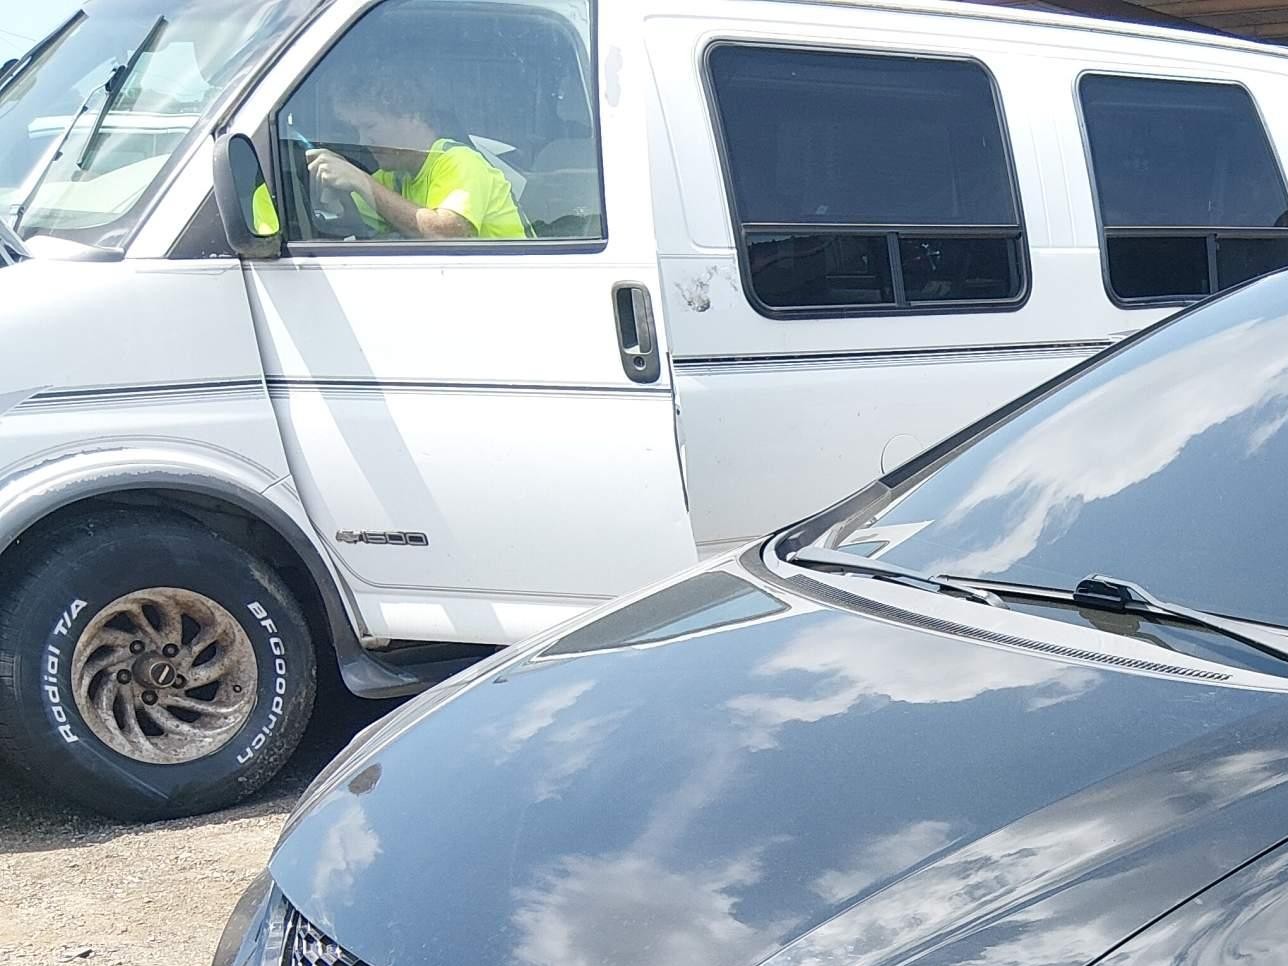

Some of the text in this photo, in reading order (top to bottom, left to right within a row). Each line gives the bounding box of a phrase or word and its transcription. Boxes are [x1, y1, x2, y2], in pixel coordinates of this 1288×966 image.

[43, 598, 88, 744] Radial T/A
[236, 600, 287, 764] BFGoodrich
